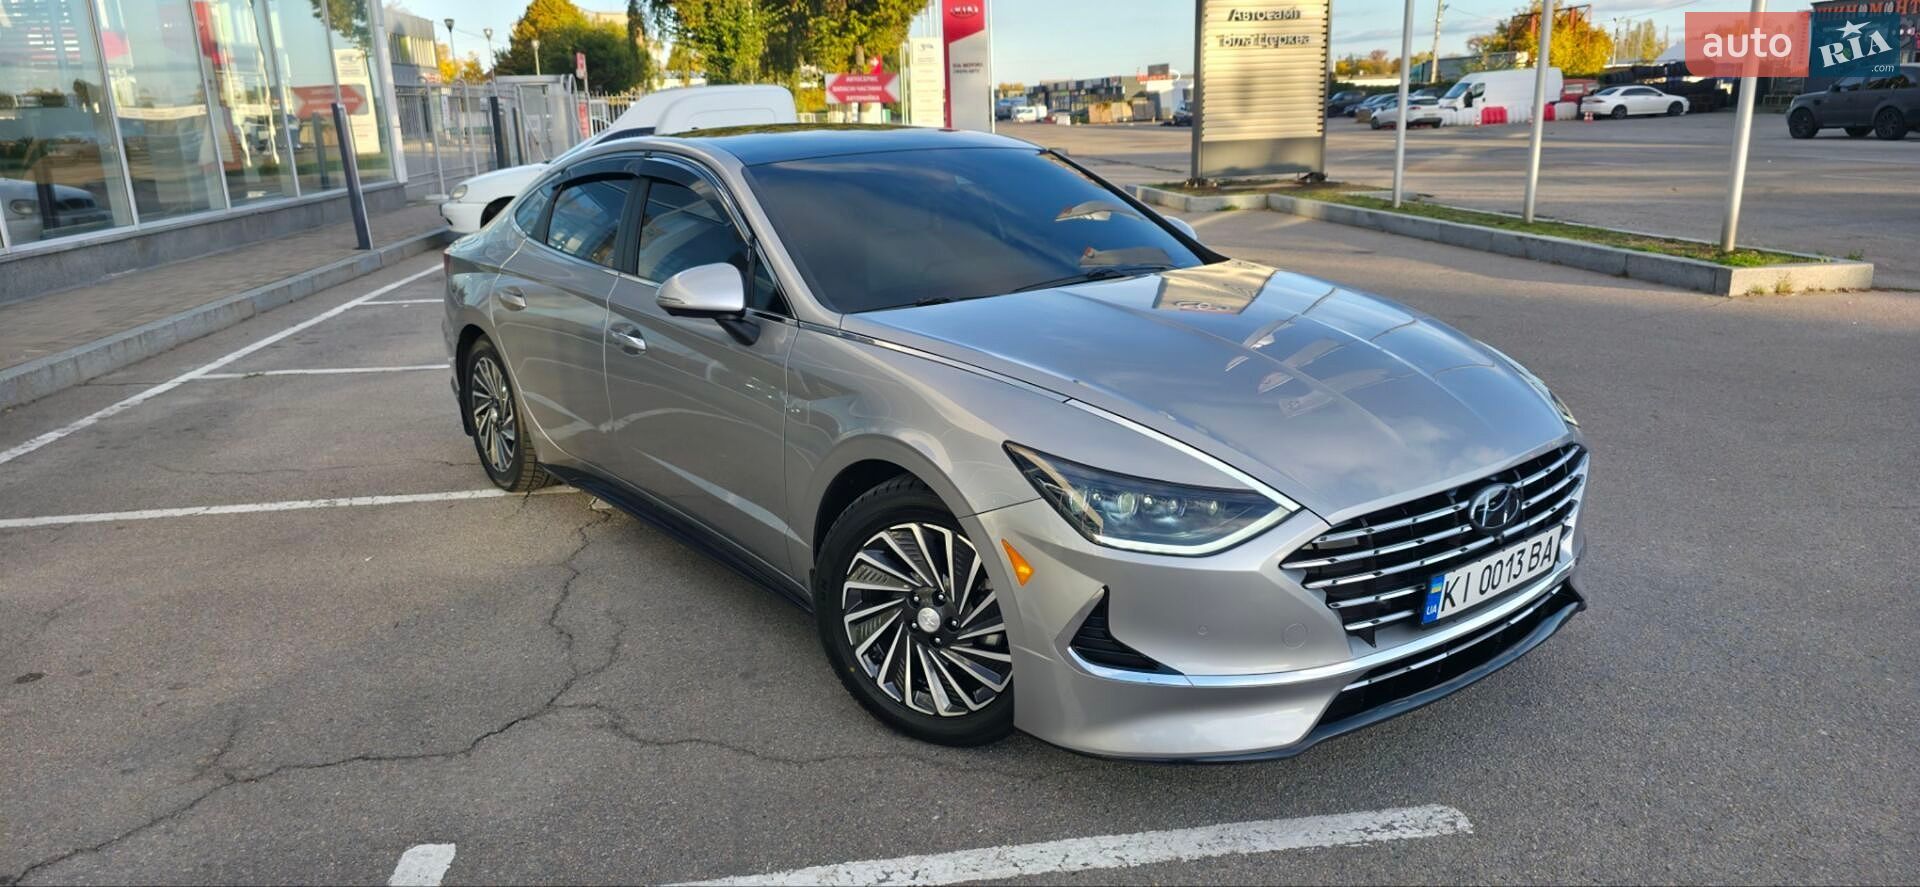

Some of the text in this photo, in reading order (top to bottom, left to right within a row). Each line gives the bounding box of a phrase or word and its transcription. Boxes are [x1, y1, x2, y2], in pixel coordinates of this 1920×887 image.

[1441, 535, 1553, 612] KI 0013 BA
[1426, 604, 1438, 615] UA
